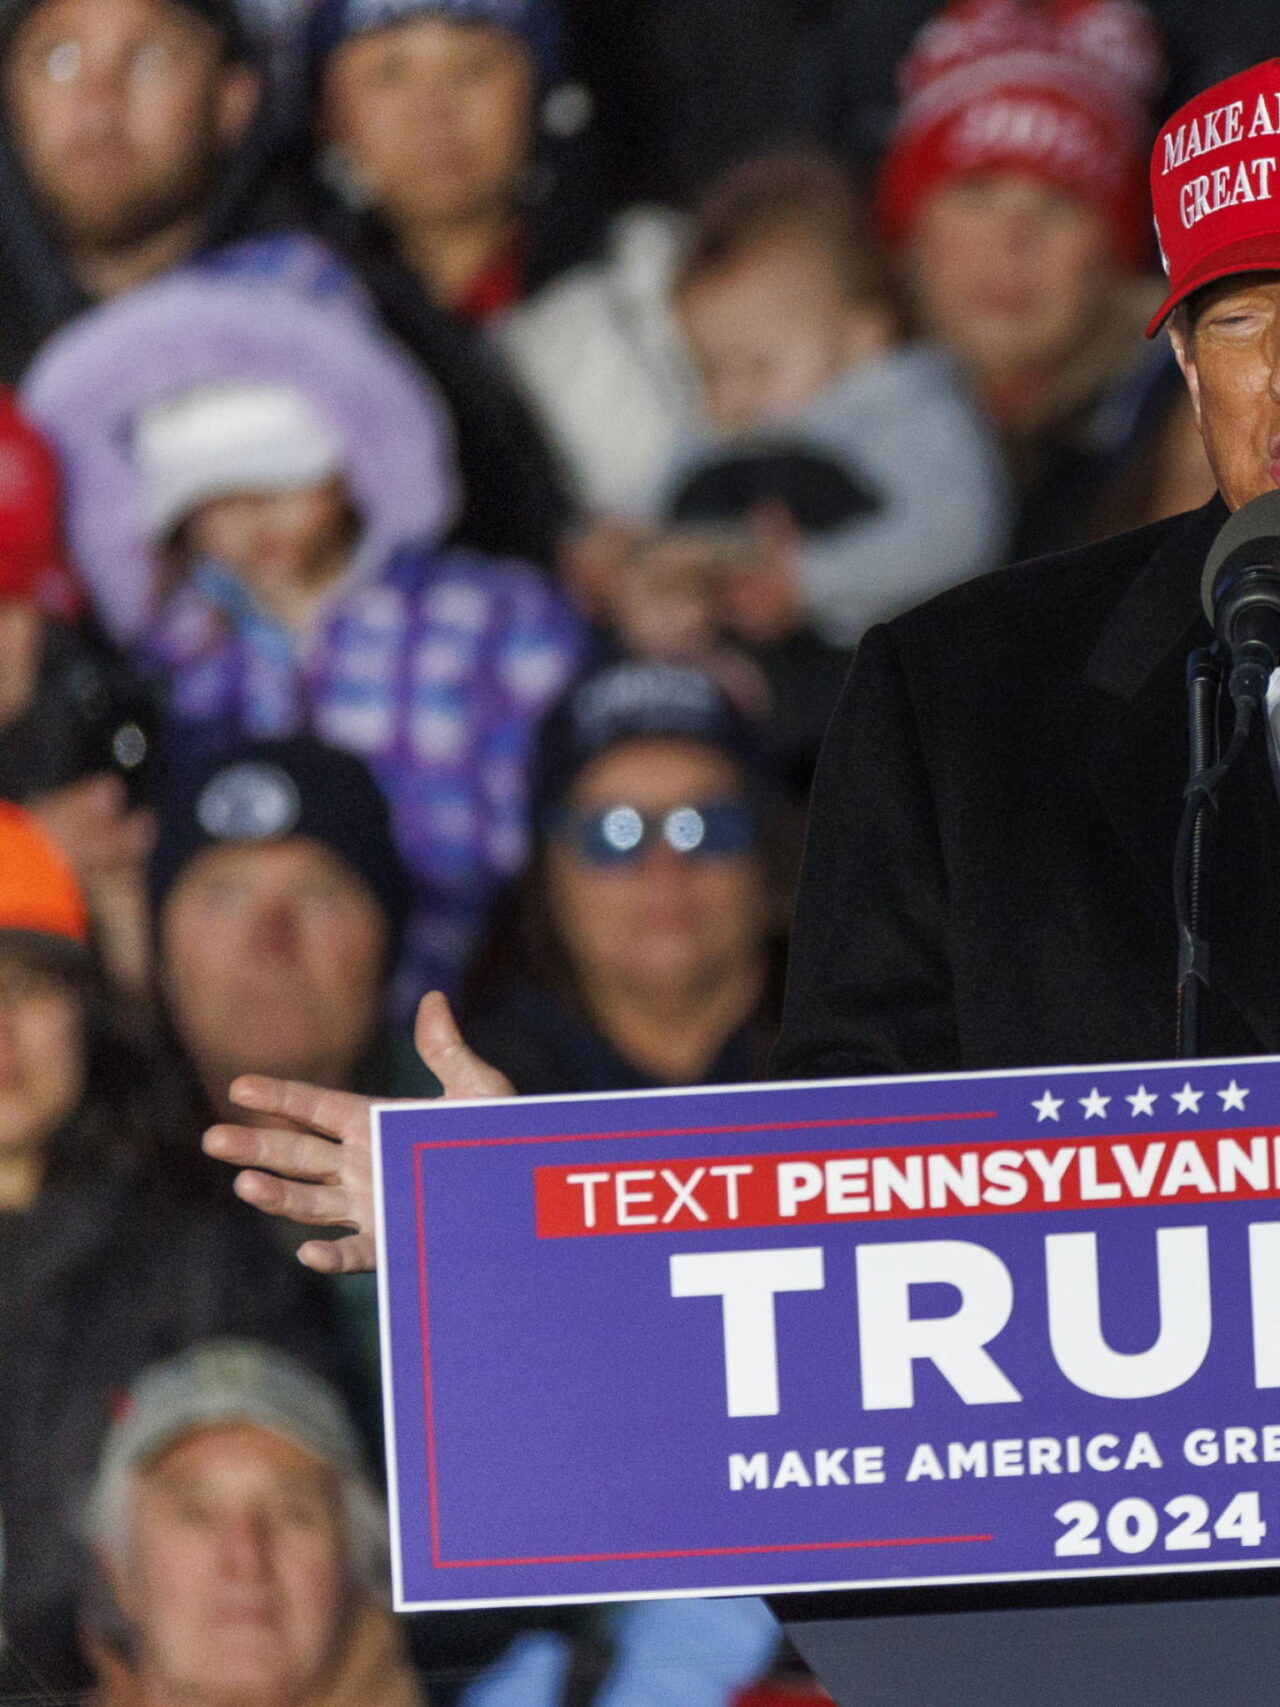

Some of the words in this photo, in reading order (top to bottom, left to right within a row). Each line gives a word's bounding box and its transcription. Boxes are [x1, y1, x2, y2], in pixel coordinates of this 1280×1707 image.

[1161, 100, 1244, 176] MAKE
[1179, 157, 1277, 230] GREAT
[566, 1164, 753, 1228] TEXT
[728, 1446, 886, 1491] MAKE
[905, 1431, 1163, 1482] AMERICA
[1054, 1491, 1267, 1557] 2024
